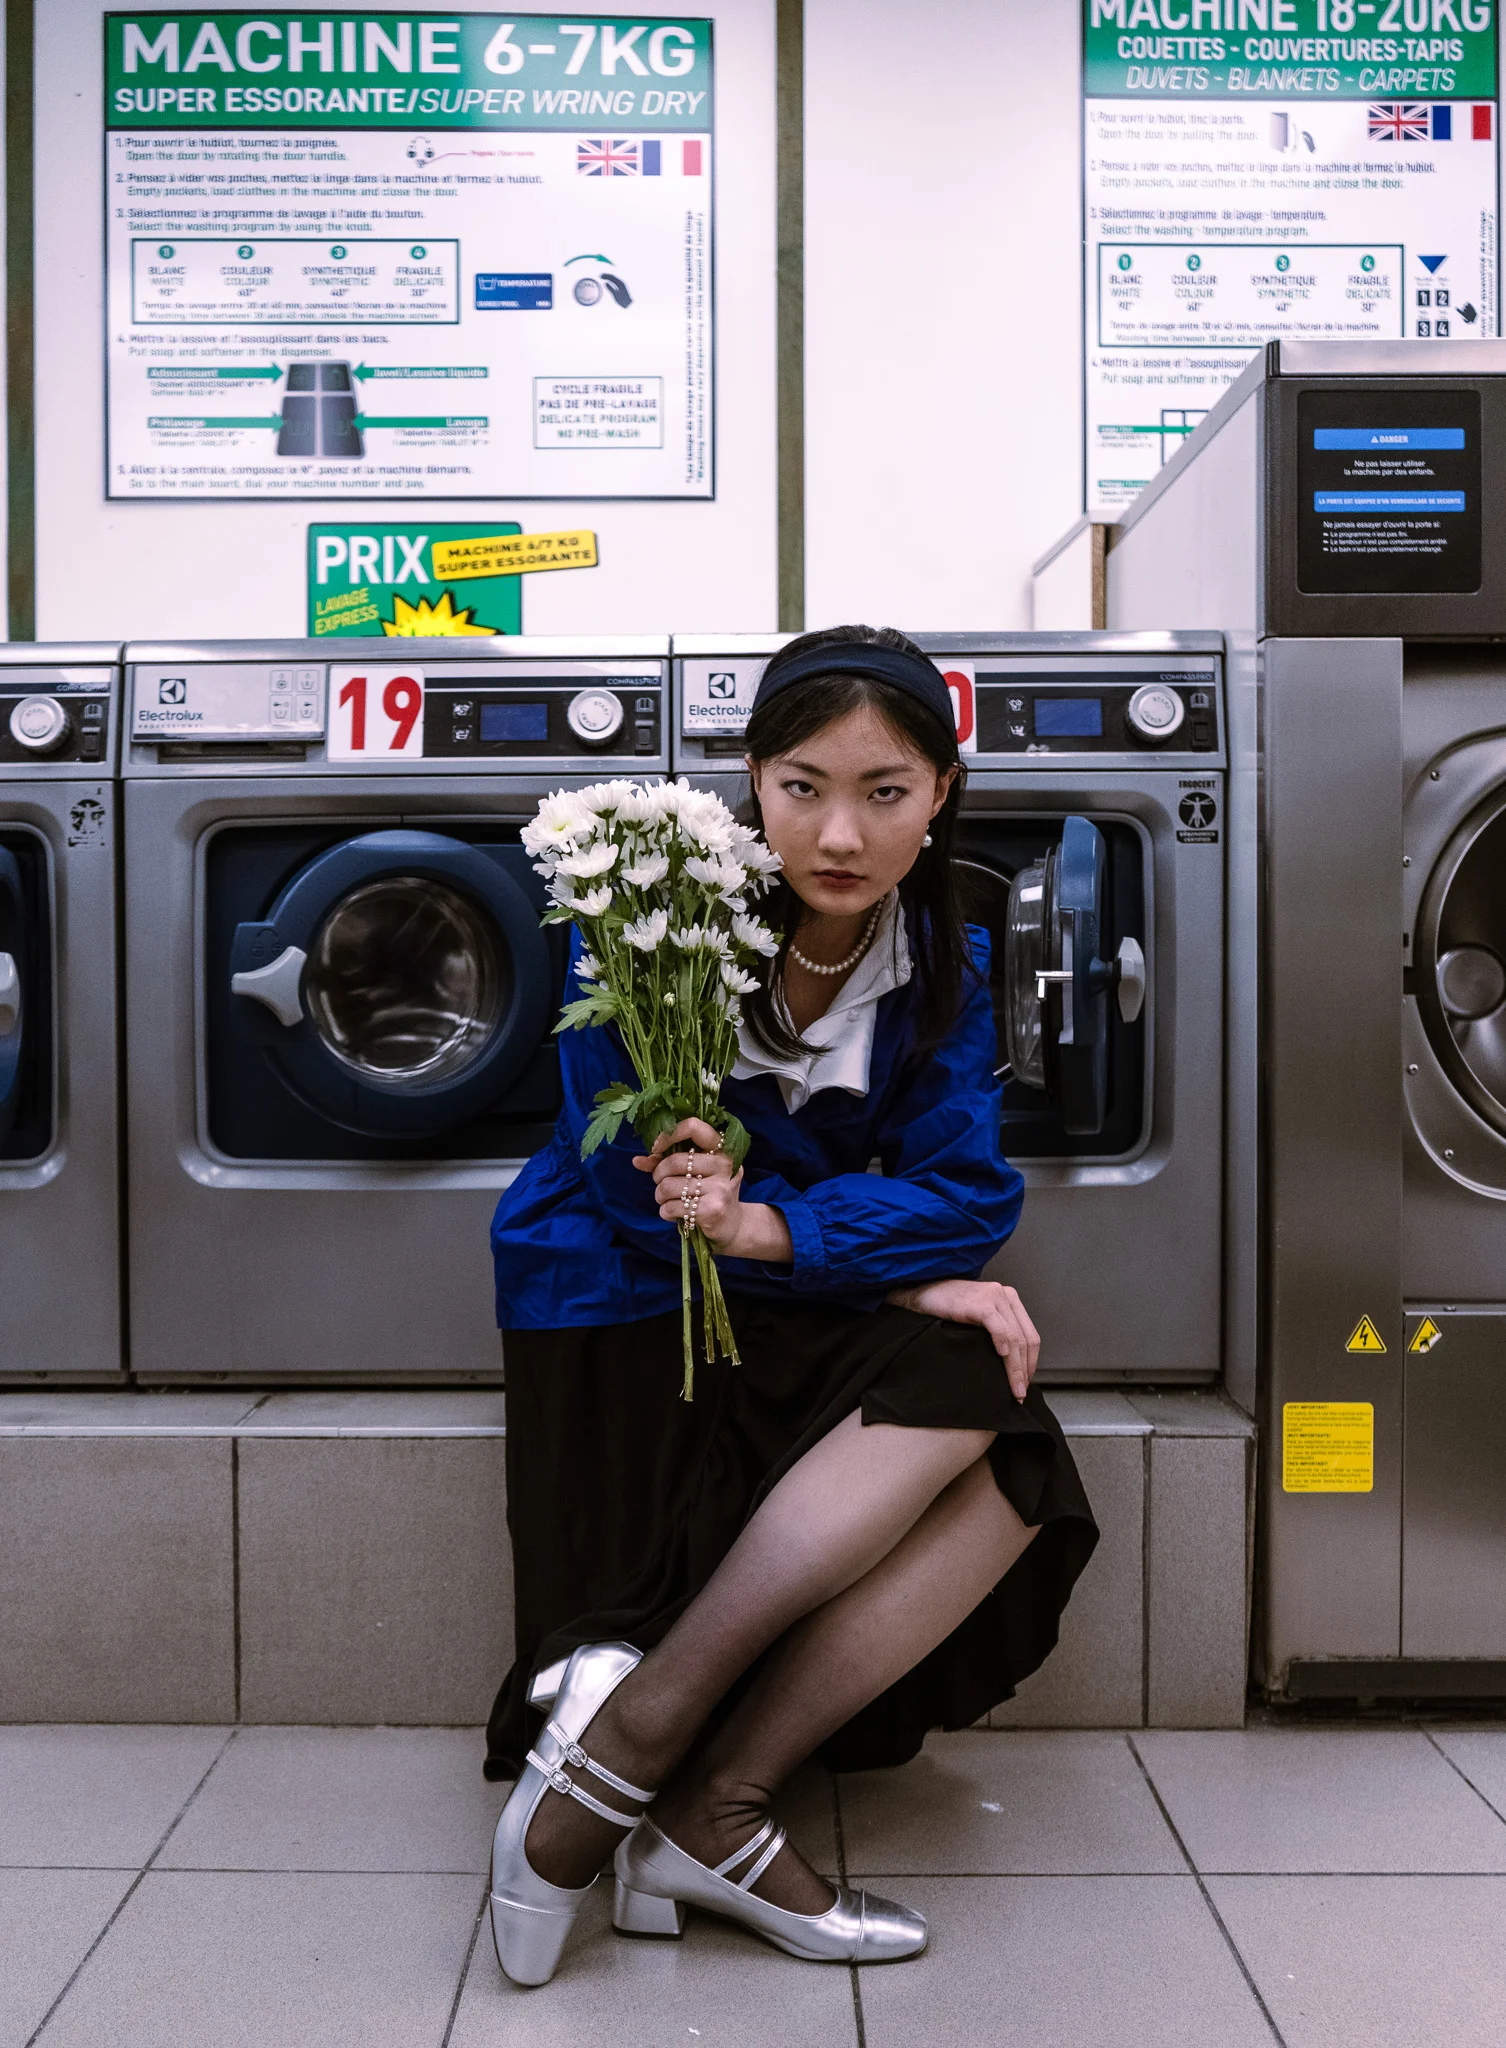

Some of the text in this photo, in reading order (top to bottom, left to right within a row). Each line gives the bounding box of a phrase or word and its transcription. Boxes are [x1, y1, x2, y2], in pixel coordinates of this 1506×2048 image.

[1091, 0, 1491, 32] MACHINE 18-20KG
[123, 21, 695, 76] MACHINE 6-7KG
[1117, 35, 1226, 60] COUETTES
[1126, 65, 1456, 92] DUVETS BLANKETS CARPETS
[115, 87, 217, 113] SUPER
[533, 89, 635, 115] WRING
[641, 90, 706, 116] DRY
[552, 384, 644, 394] CYCLE FRAGILE
[538, 400, 560, 409] PAS
[565, 400, 579, 409] DE
[1379, 435, 1408, 444] DANGER
[316, 535, 430, 585] PRIX
[448, 537, 579, 558] MACHINE 6/7 KG
[437, 549, 592, 573] SUPER ESSORANTE
[316, 587, 370, 615] LAVAGE
[315, 604, 379, 635] EXPRESS
[139, 710, 203, 721] Electrolux
[339, 676, 422, 750] 19
[689, 704, 752, 716] Electrolux
